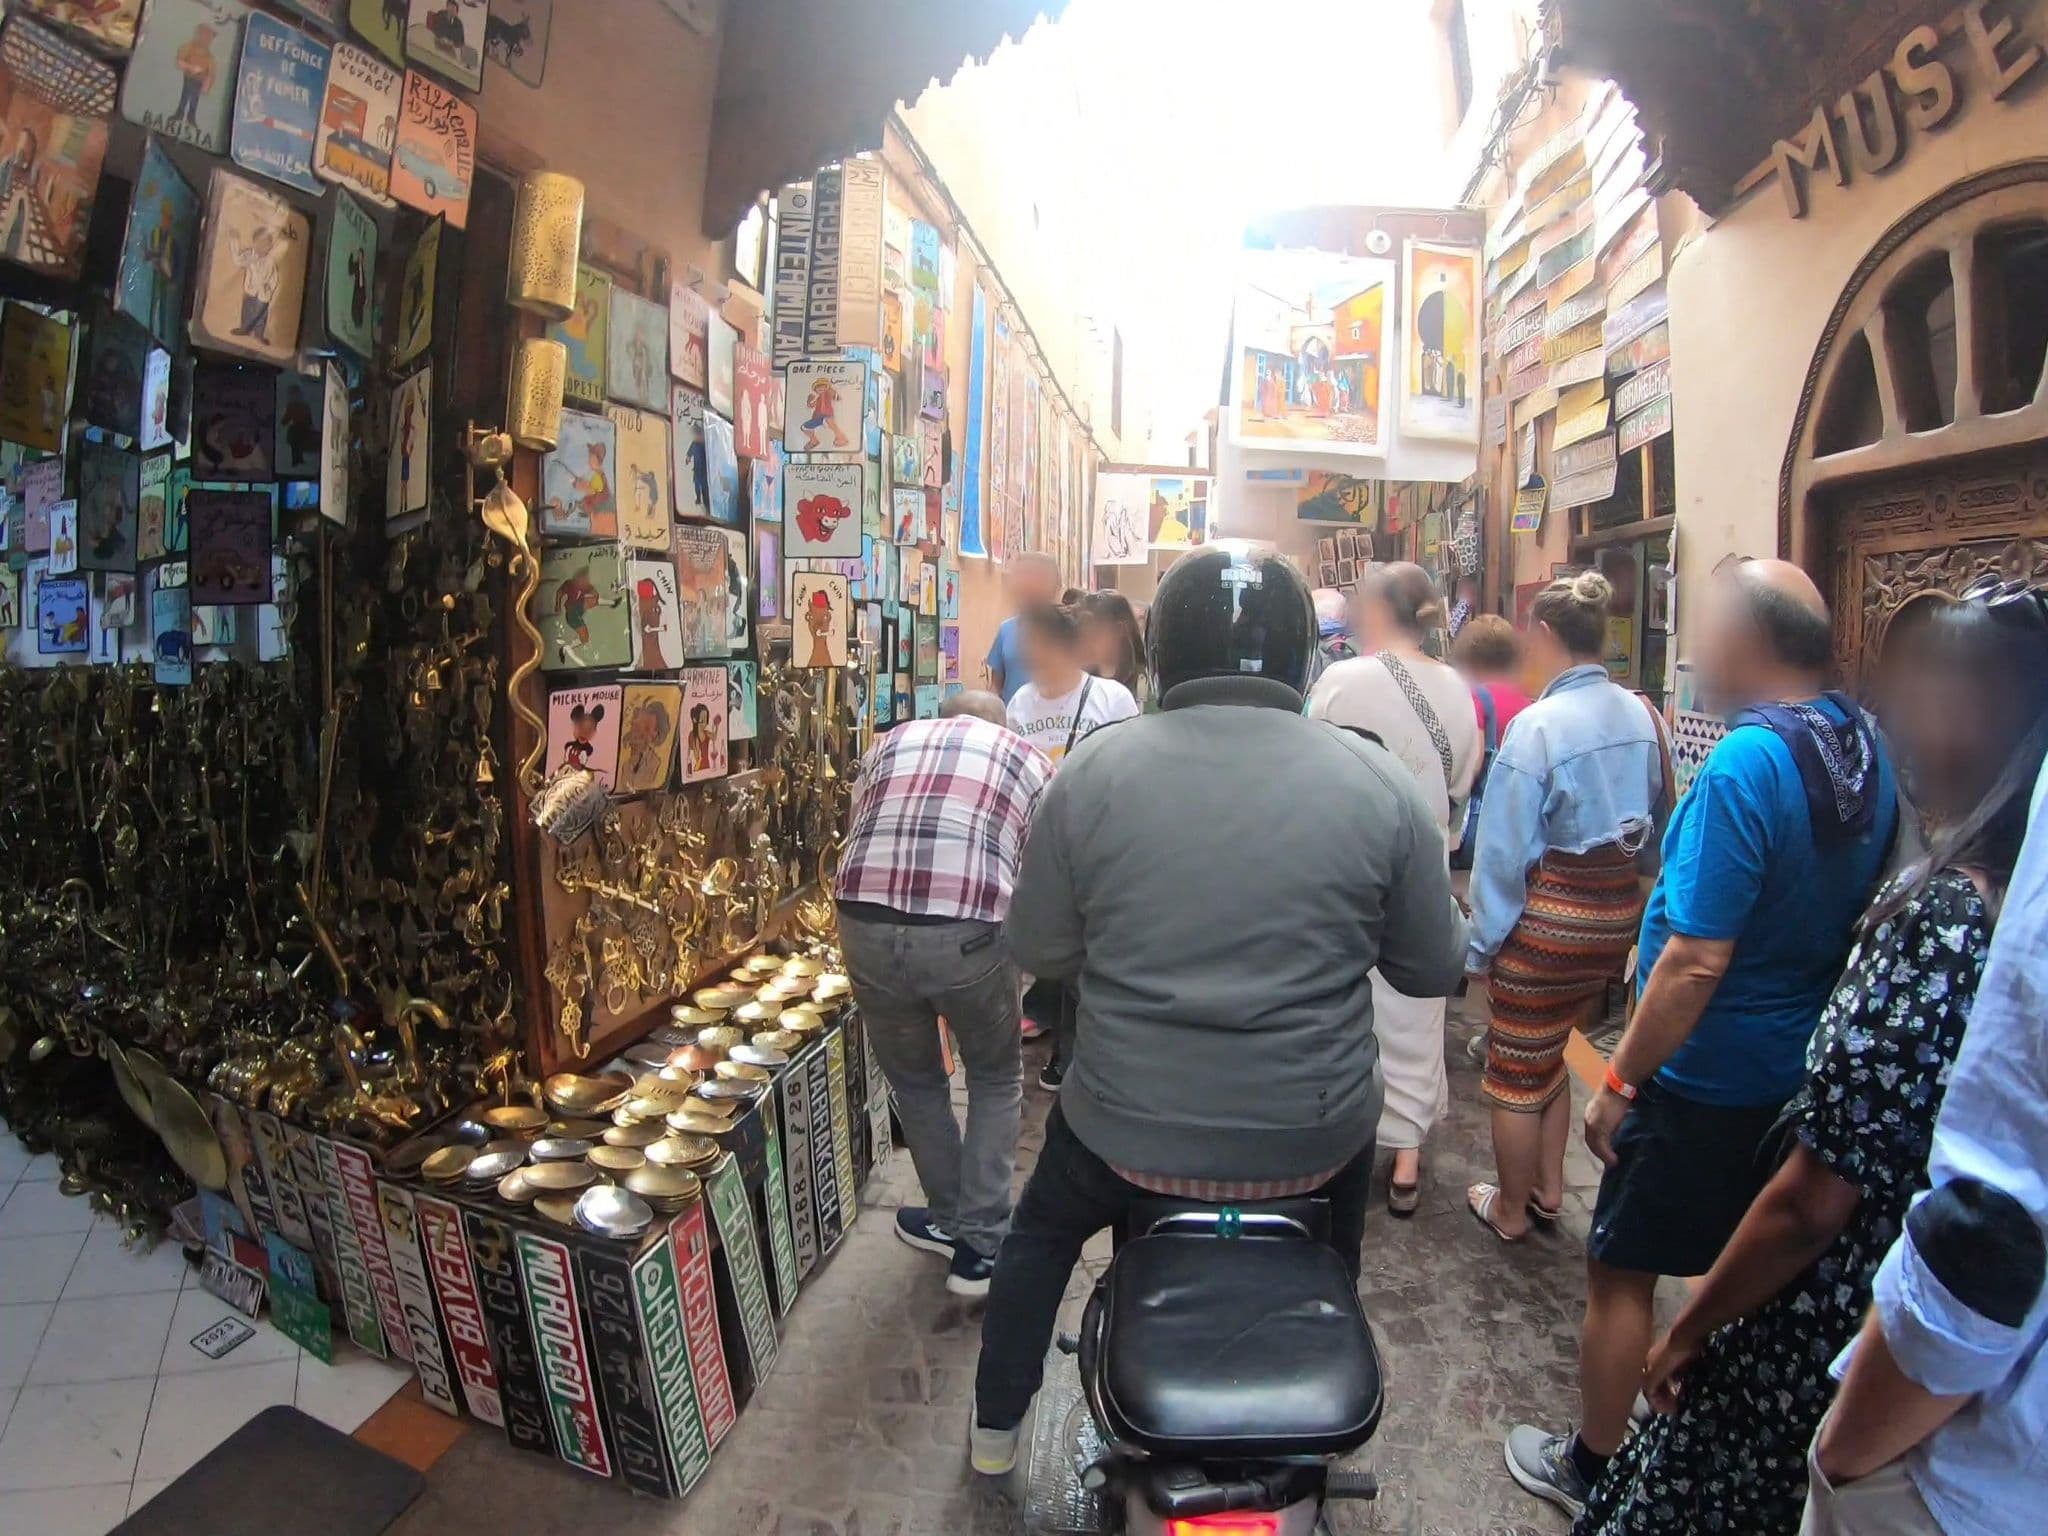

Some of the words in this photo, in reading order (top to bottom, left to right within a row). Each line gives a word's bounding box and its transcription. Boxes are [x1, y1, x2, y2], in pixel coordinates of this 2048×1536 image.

[808, 200, 839, 351] MARRAKECH
[792, 364, 812, 374] ONE
[816, 364, 846, 374] PIECE
[656, 569, 674, 595] CHIN
[828, 580, 843, 600] CHIN
[552, 692, 590, 706] MICKEY
[592, 689, 620, 702] MOUSE
[787, 1079, 802, 1114] 26
[807, 1053, 840, 1221] MARRAKECH
[793, 1180, 814, 1269] 75268
[426, 1211, 486, 1351] BAYERN
[527, 1244, 587, 1403] MOROCCO
[724, 1205, 779, 1381] MARRAKECH
[199, 1322, 236, 1347] 2023
[403, 1304, 450, 1403] 63232
[463, 1354, 496, 1399] FC
[681, 1257, 733, 1446] MARRAKECH
[645, 1285, 706, 1483] MARRAKECH
[615, 1411, 659, 1483] 1977
